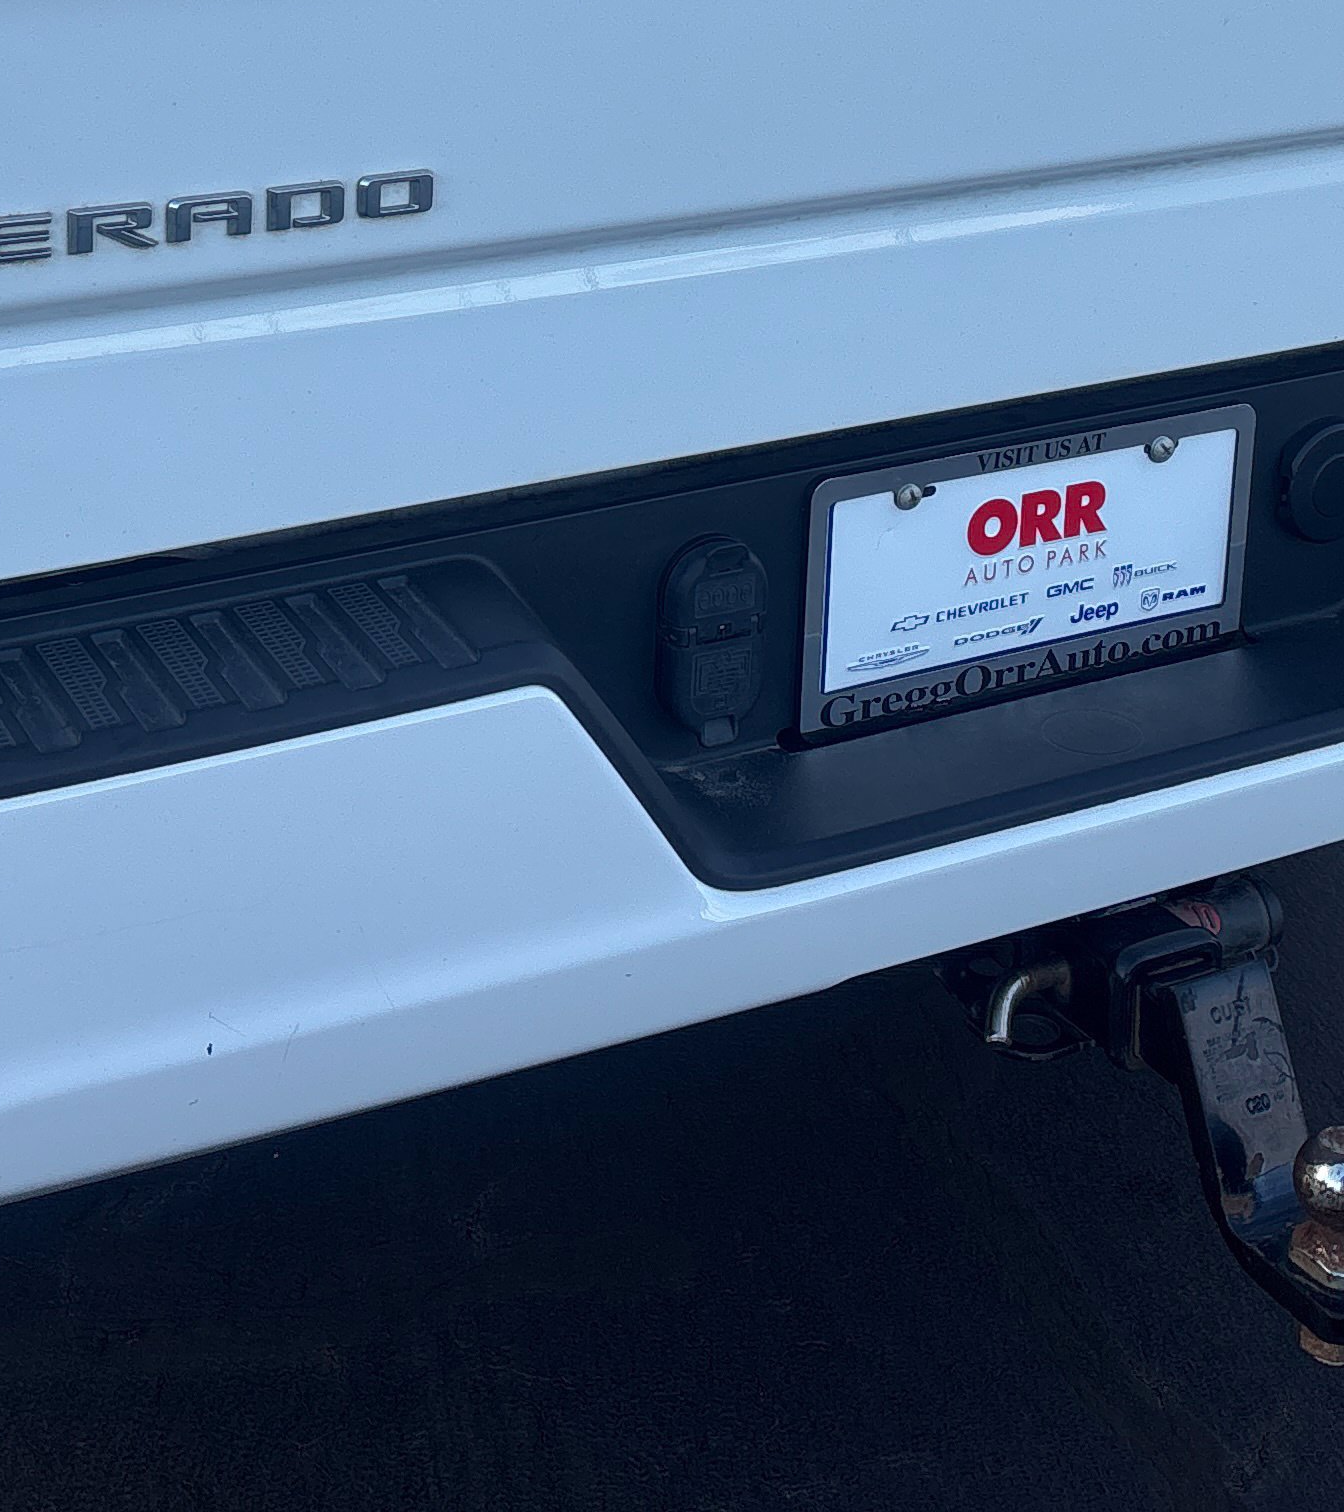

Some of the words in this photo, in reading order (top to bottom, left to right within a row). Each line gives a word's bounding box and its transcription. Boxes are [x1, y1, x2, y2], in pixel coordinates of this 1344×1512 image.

[976, 444, 1039, 472] VISIT
[1044, 438, 1072, 460] US
[1077, 432, 1107, 453] AT
[967, 480, 1107, 557] ORR
[963, 554, 1035, 587] AUTO
[1045, 539, 1107, 570] PARK
[1134, 561, 1178, 578] BUICK
[1046, 577, 1095, 599] GMC
[1161, 584, 1207, 602] RAM
[935, 591, 1030, 624] CHEVROLET
[1070, 600, 1119, 625] Jeep
[953, 620, 1031, 648] DODGE
[858, 643, 920, 663] CHRYSLER
[819, 618, 1223, 729] GreggOrrAuto.com
